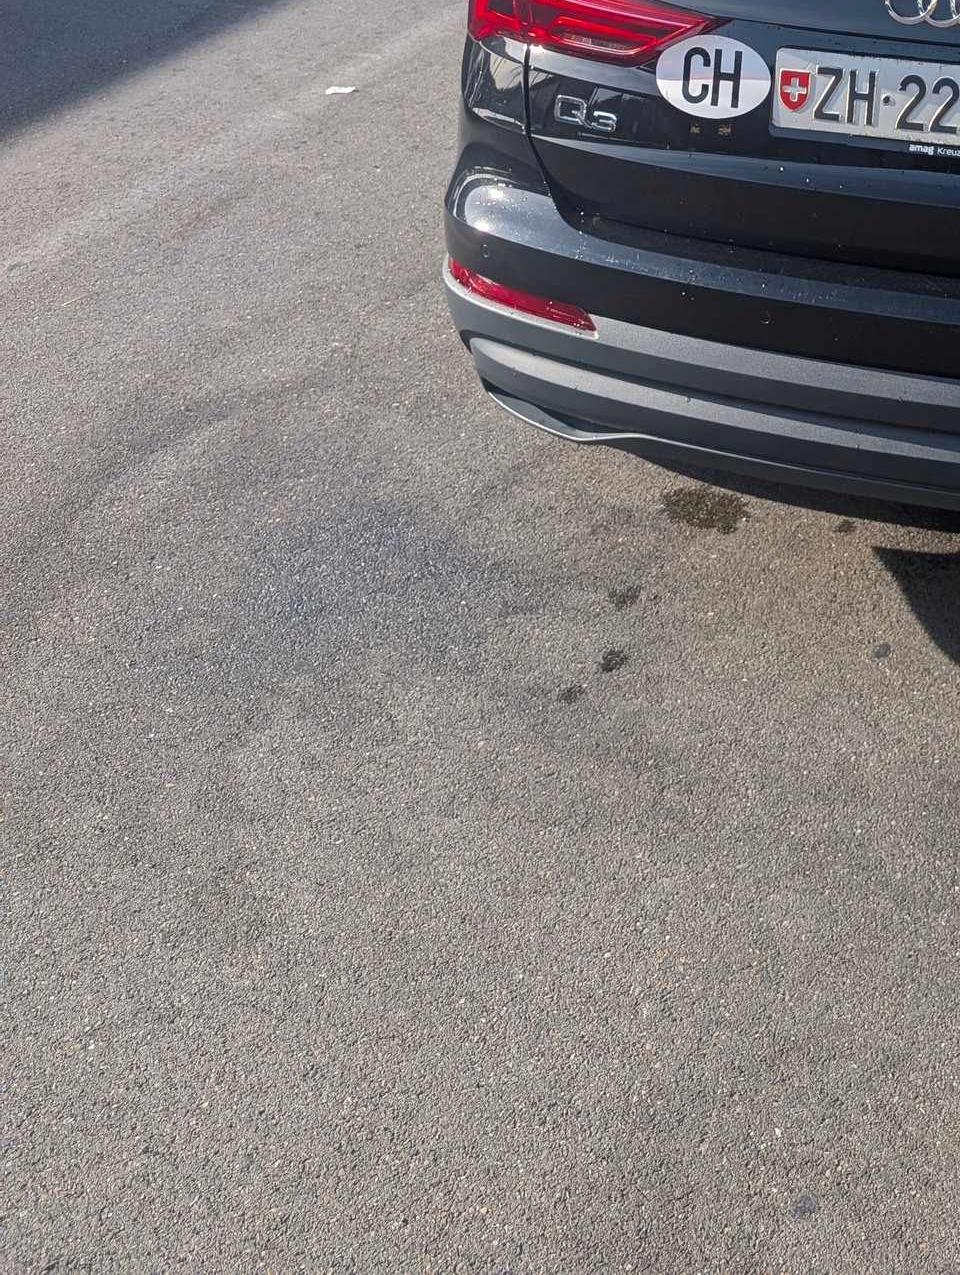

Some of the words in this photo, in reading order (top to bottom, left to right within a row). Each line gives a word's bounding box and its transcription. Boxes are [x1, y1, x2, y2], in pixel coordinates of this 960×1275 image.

[681, 46, 744, 110] CH
[554, 94, 618, 133] Q3
[909, 144, 935, 155] amag
